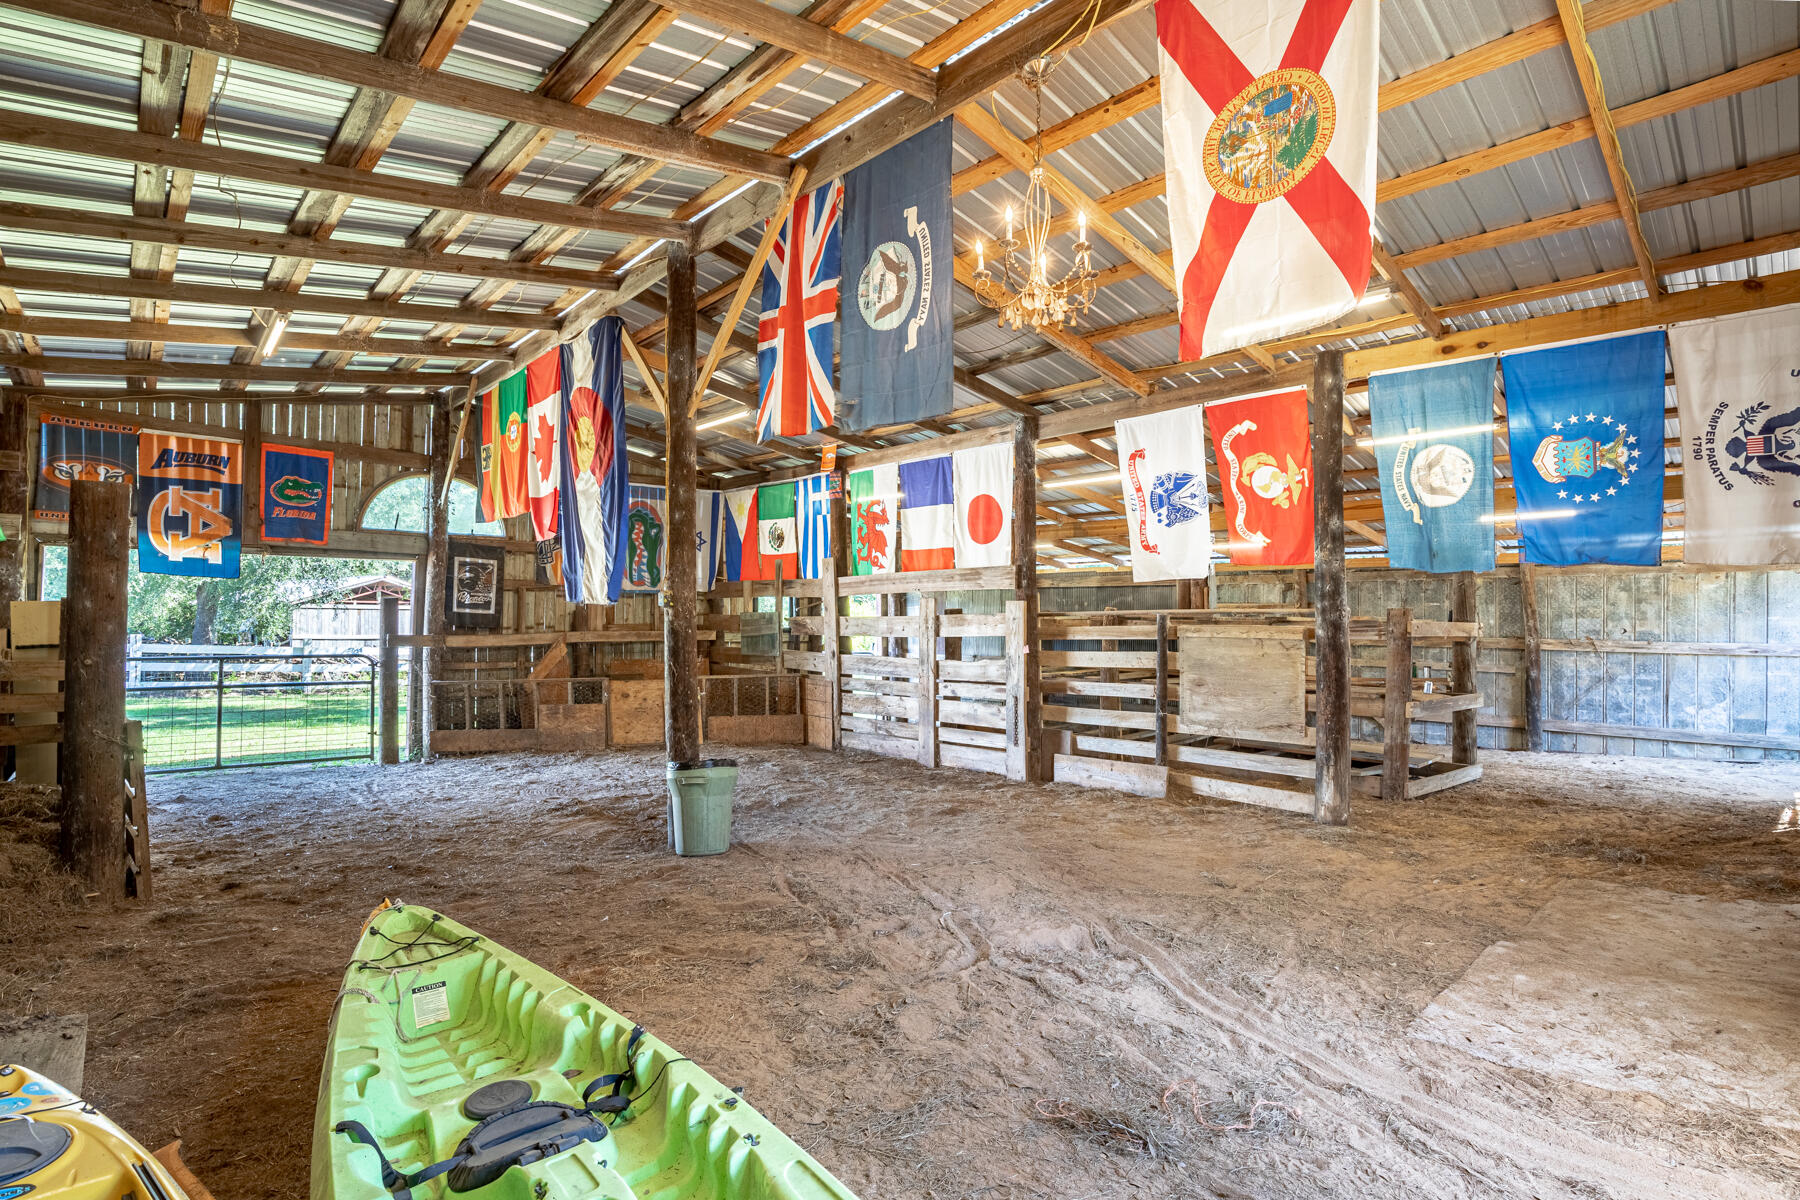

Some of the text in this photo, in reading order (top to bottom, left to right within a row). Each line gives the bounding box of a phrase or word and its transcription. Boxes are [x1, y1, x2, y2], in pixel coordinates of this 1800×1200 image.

[49, 415, 134, 432] AUBURN
[1222, 429, 1237, 451] UNITED
[1692, 435, 1704, 461] 1790
[1705, 401, 1734, 491] SEMPER PARATUS
[150, 448, 232, 470] AUBURN
[1128, 459, 1140, 489] UNITED
[1395, 446, 1412, 509] UNITED STATES NAVY
[271, 506, 317, 520] FLORIDA
[415, 982, 444, 993] CAUTION
